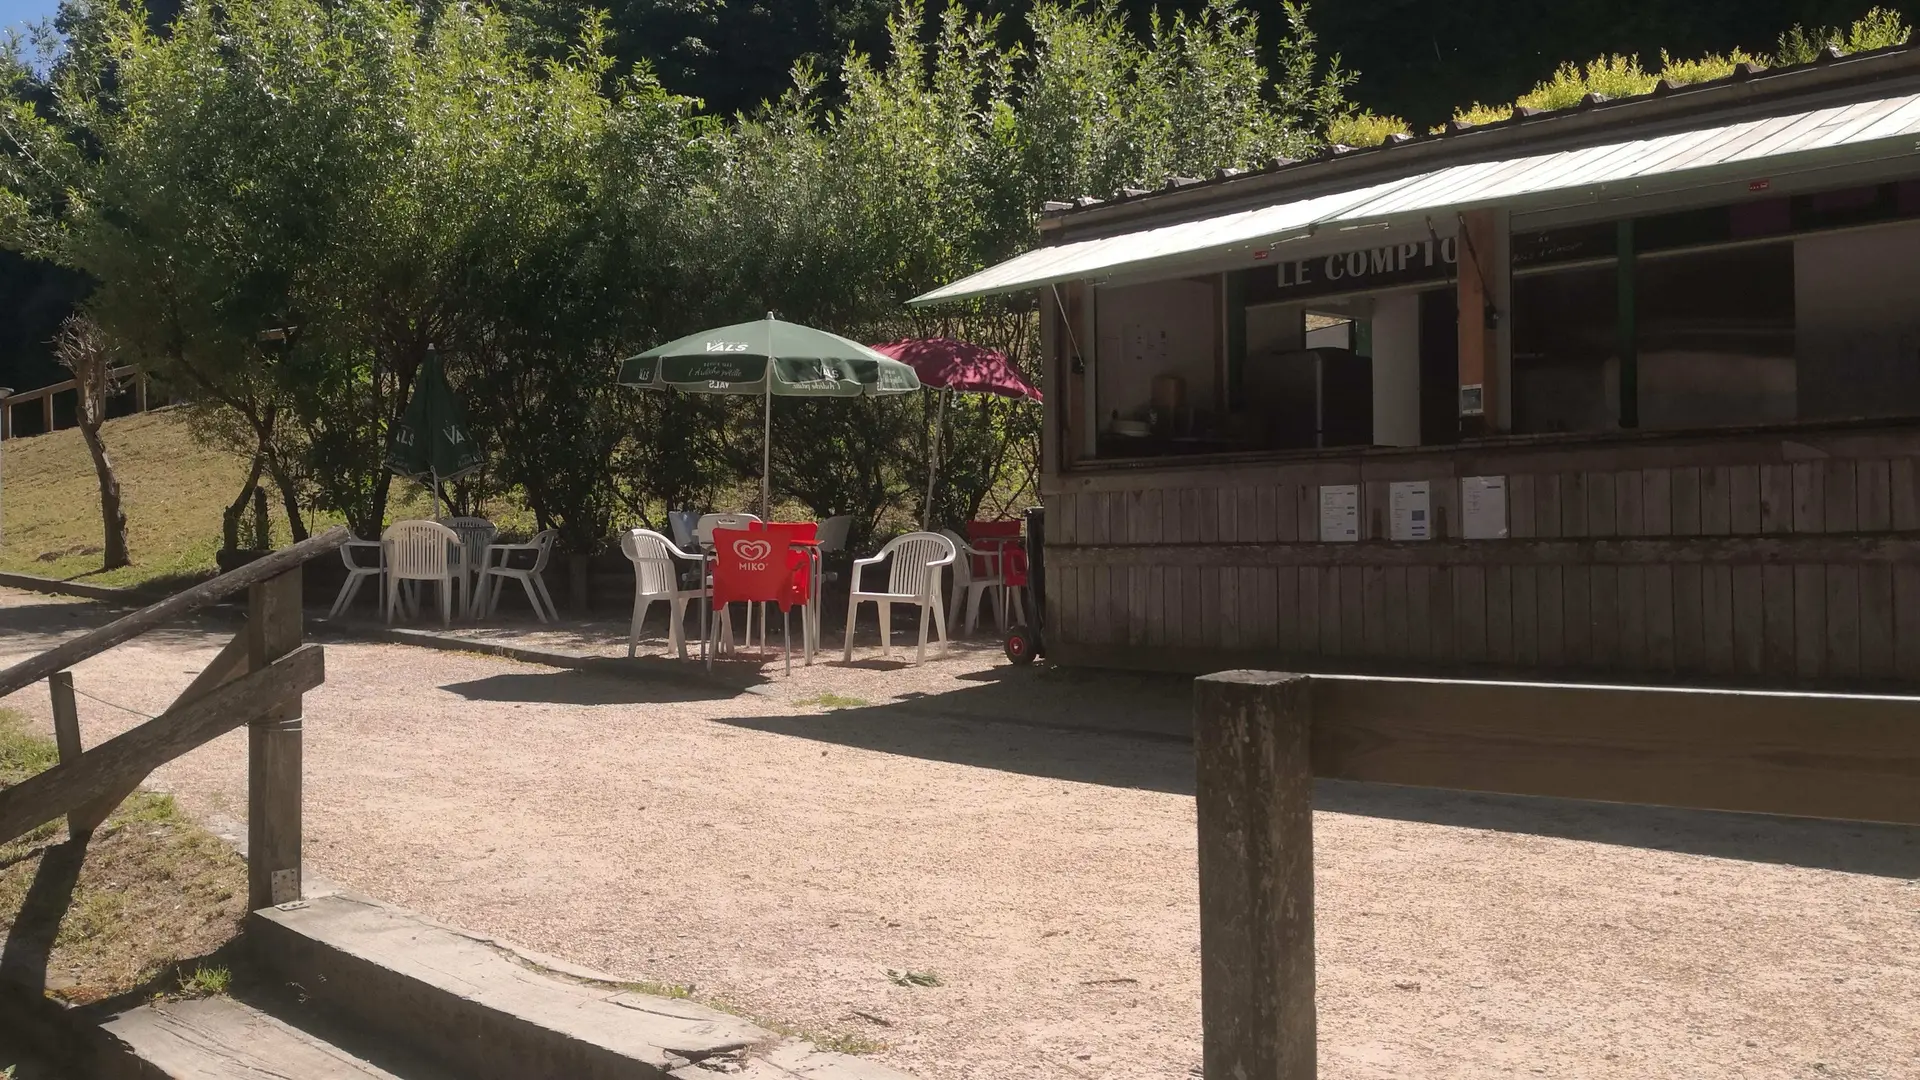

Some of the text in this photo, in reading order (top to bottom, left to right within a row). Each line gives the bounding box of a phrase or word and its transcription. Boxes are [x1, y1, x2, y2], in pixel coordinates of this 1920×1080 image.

[1277, 260, 1312, 288] LE
[706, 342, 749, 352] VALS
[738, 562, 766, 571] MIKO
